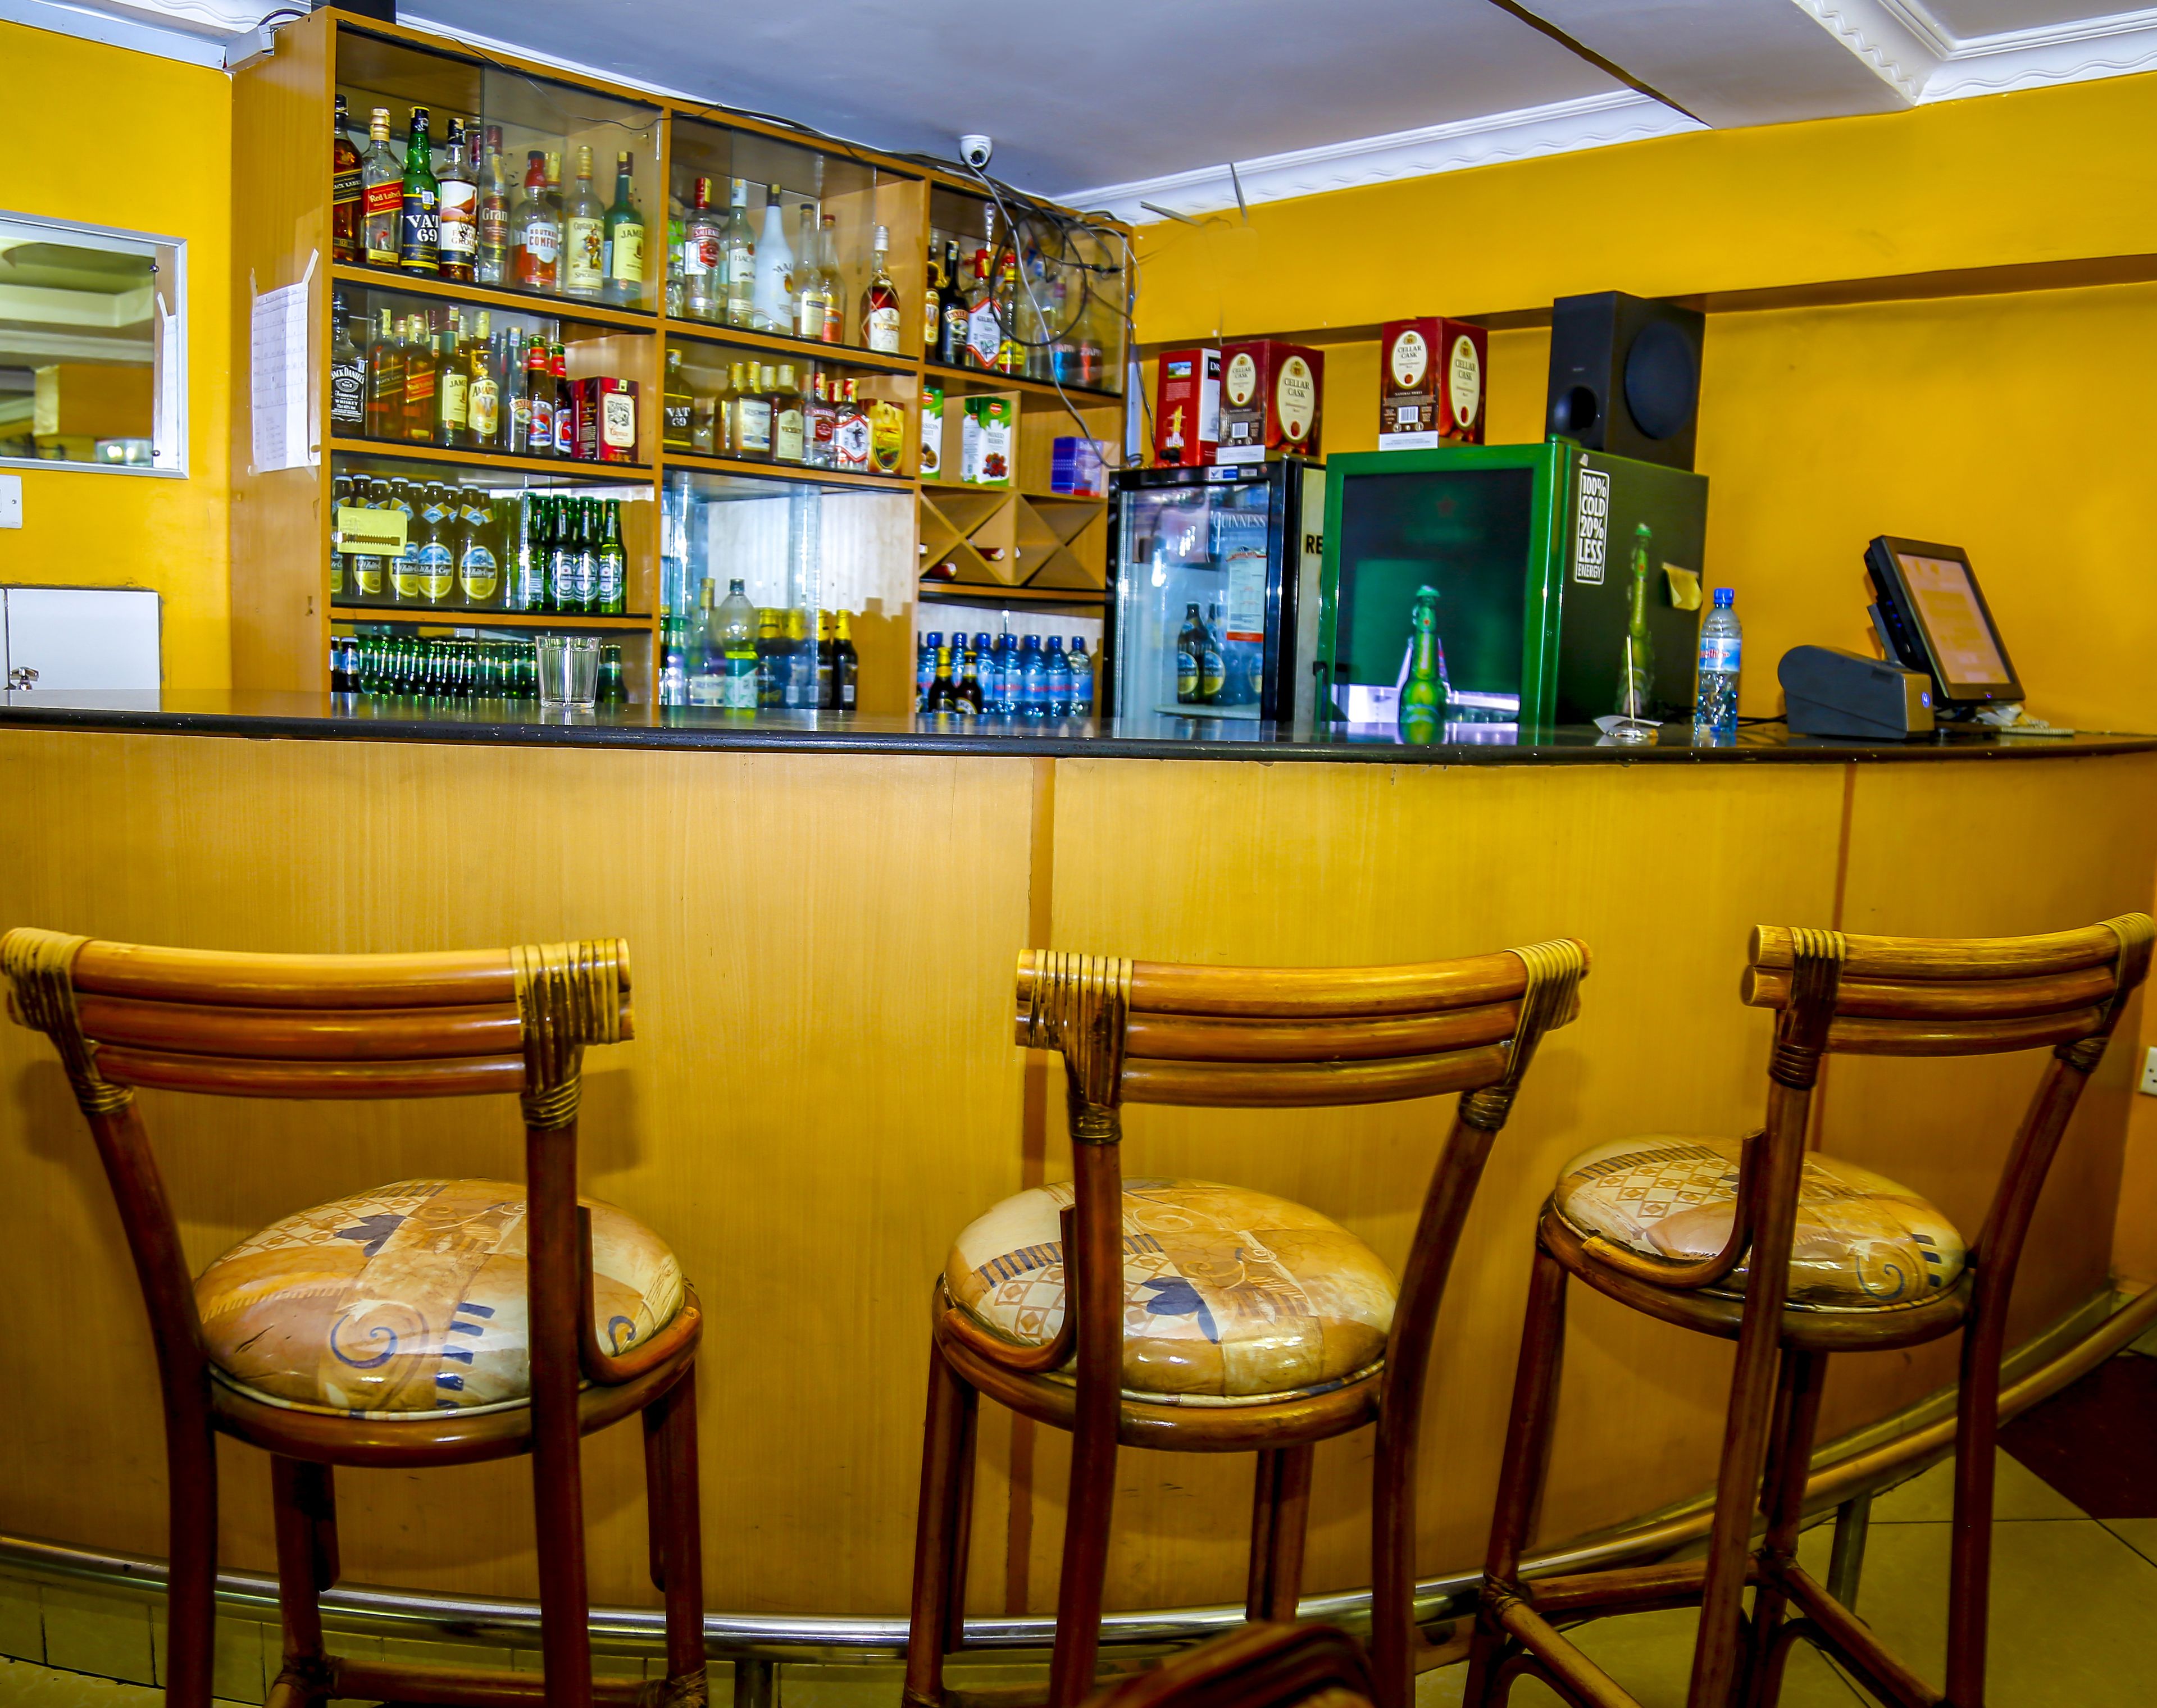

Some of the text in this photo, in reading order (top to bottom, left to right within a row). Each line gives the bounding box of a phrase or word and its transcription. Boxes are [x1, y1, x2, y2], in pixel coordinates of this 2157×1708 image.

[369, 190, 401, 203] Red Label
[406, 214, 440, 229] VAT
[417, 229, 438, 242] 69
[1398, 345, 1422, 354] CELLAR
[1456, 358, 1477, 372] CELLAR
[1458, 371, 1473, 381] CASK
[1285, 377, 1310, 390] CELLAR
[1288, 388, 1305, 398] CASK
[665, 407, 690, 417] VAT
[672, 417, 687, 426] 69
[1582, 475, 1607, 498] 100%
[1581, 495, 1606, 517] COLD
[1213, 512, 1266, 529] GUINNESS
[1580, 515, 1605, 539] 20%
[1307, 534, 1323, 554] RE
[1578, 538, 1604, 565] LESS
[1577, 563, 1602, 579] ENERGY
